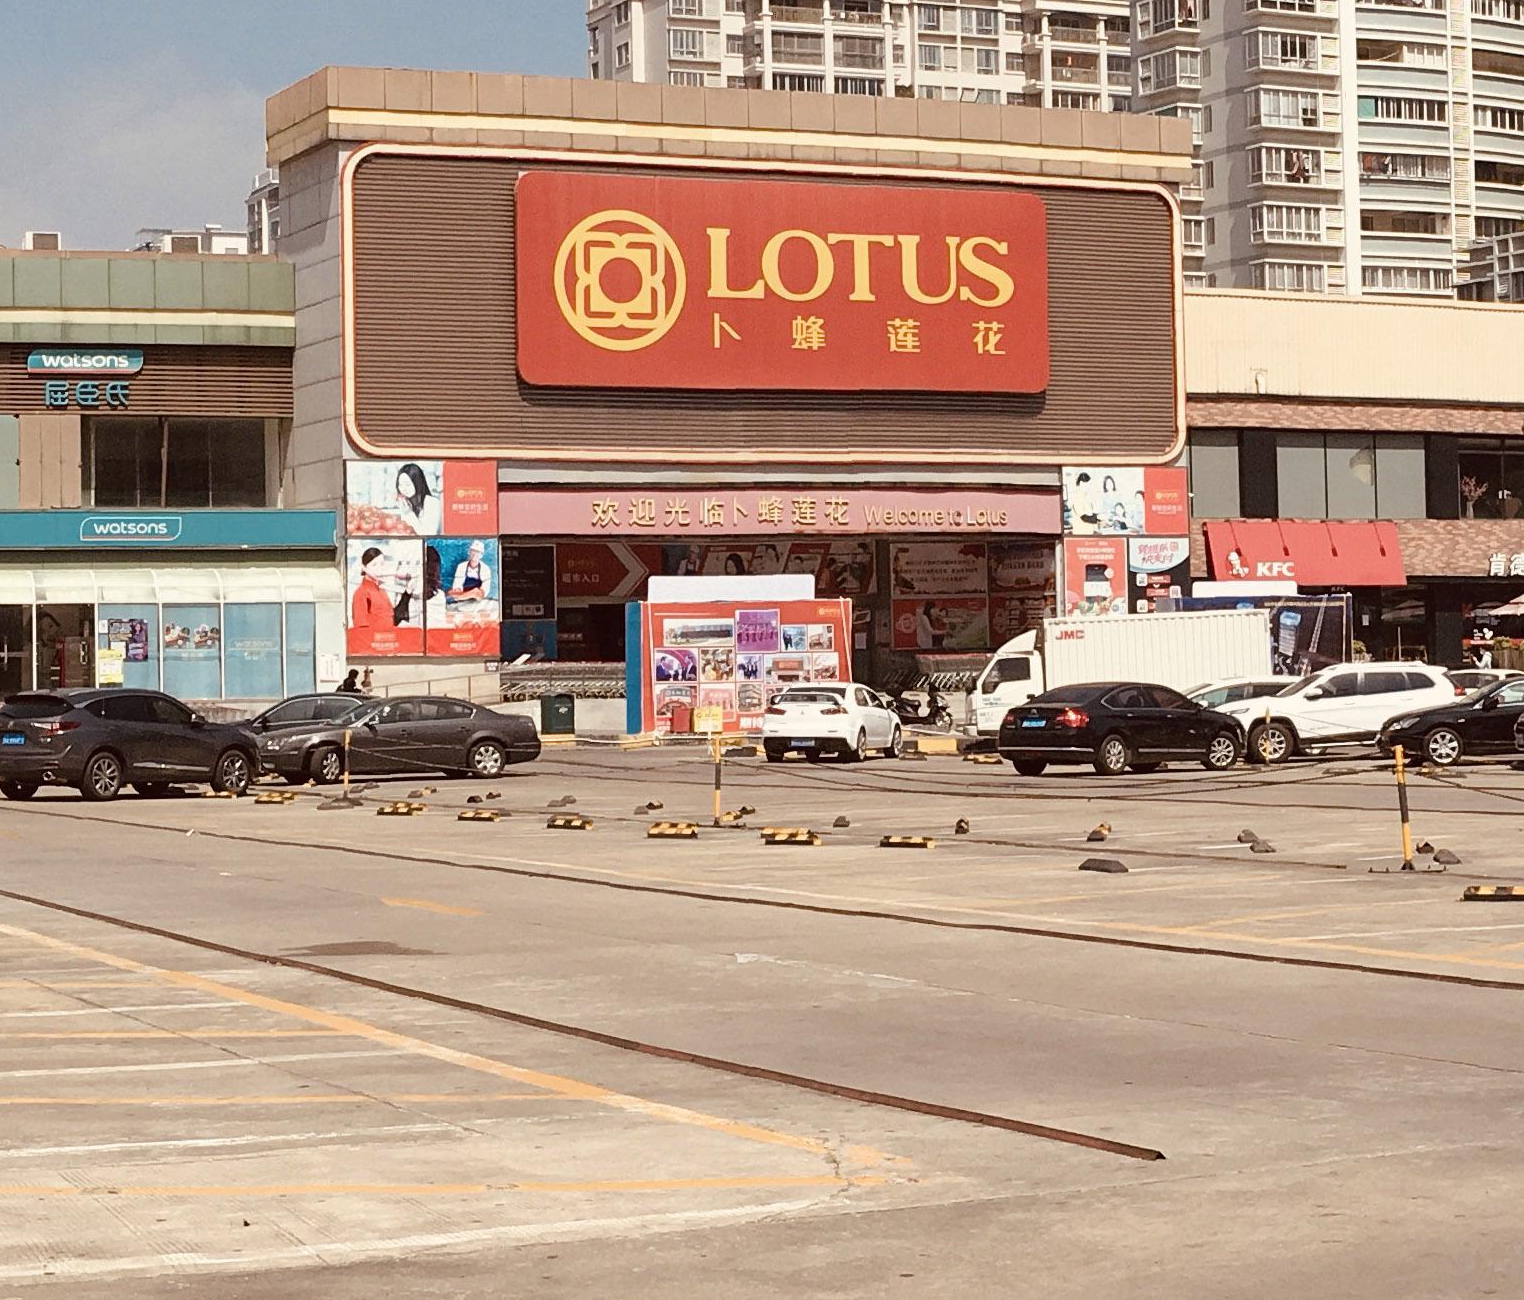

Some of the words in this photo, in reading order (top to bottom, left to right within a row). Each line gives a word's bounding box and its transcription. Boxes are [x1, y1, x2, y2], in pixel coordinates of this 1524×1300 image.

[706, 227, 1015, 308] LOTUS
[713, 312, 1006, 355] 卜蜂莲花
[41, 353, 129, 368] watsons
[45, 381, 131, 406] 屈臣氏
[592, 497, 851, 527] 欢迎光临卜蜂莲花
[864, 505, 945, 526] Welcome
[966, 505, 1009, 527] Lotus
[93, 520, 168, 535] watsons
[1256, 562, 1295, 577] KFC
[1055, 630, 1085, 640] JMC
